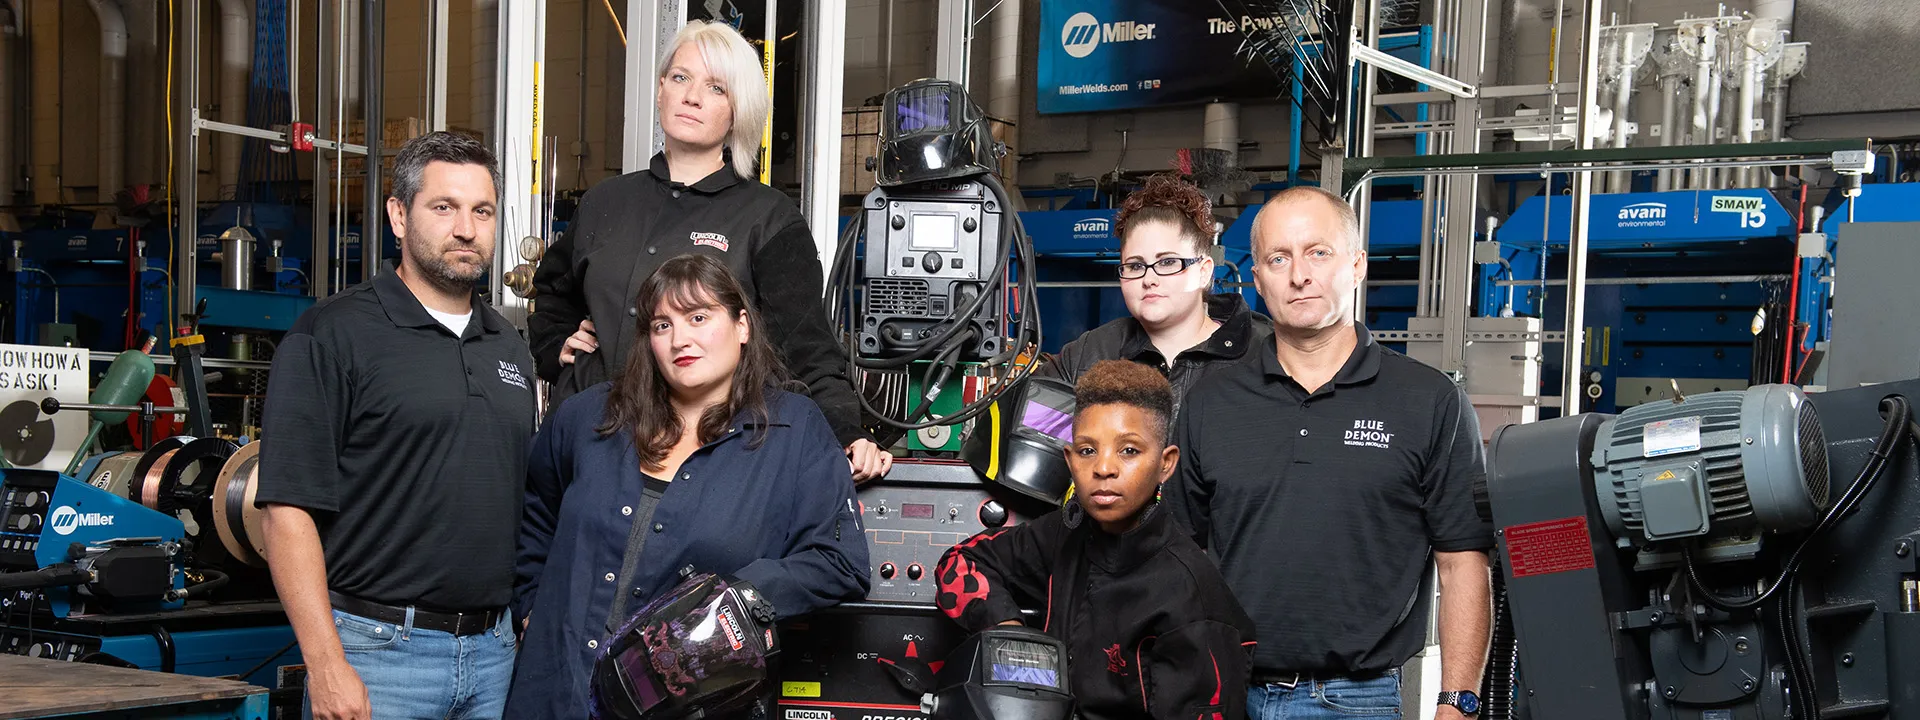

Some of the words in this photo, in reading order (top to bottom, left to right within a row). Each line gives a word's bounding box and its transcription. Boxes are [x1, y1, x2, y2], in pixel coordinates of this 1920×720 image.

[1208, 18, 1236, 35] The
[1241, 15, 1290, 32] Power
[1102, 21, 1154, 43] Miller
[1059, 83, 1128, 95] MillerWelds.com
[1714, 199, 1758, 210] SMAW
[1618, 206, 1667, 219] avani
[1073, 221, 1109, 232] avani
[1618, 219, 1665, 228] environmental
[116, 237, 124, 252] 7
[0, 350, 28, 369] OW
[32, 352, 67, 370] HOW
[71, 353, 81, 371] A
[499, 360, 520, 373] BLUE
[1354, 419, 1384, 431] BLUE
[1344, 430, 1390, 443] DEMON
[1365, 441, 1389, 449] PRODUCTS
[79, 513, 114, 526] Miller
[722, 606, 745, 641] LINCOLN
[720, 616, 739, 647] ELECTRIC
[788, 711, 828, 720] LINCOLN
